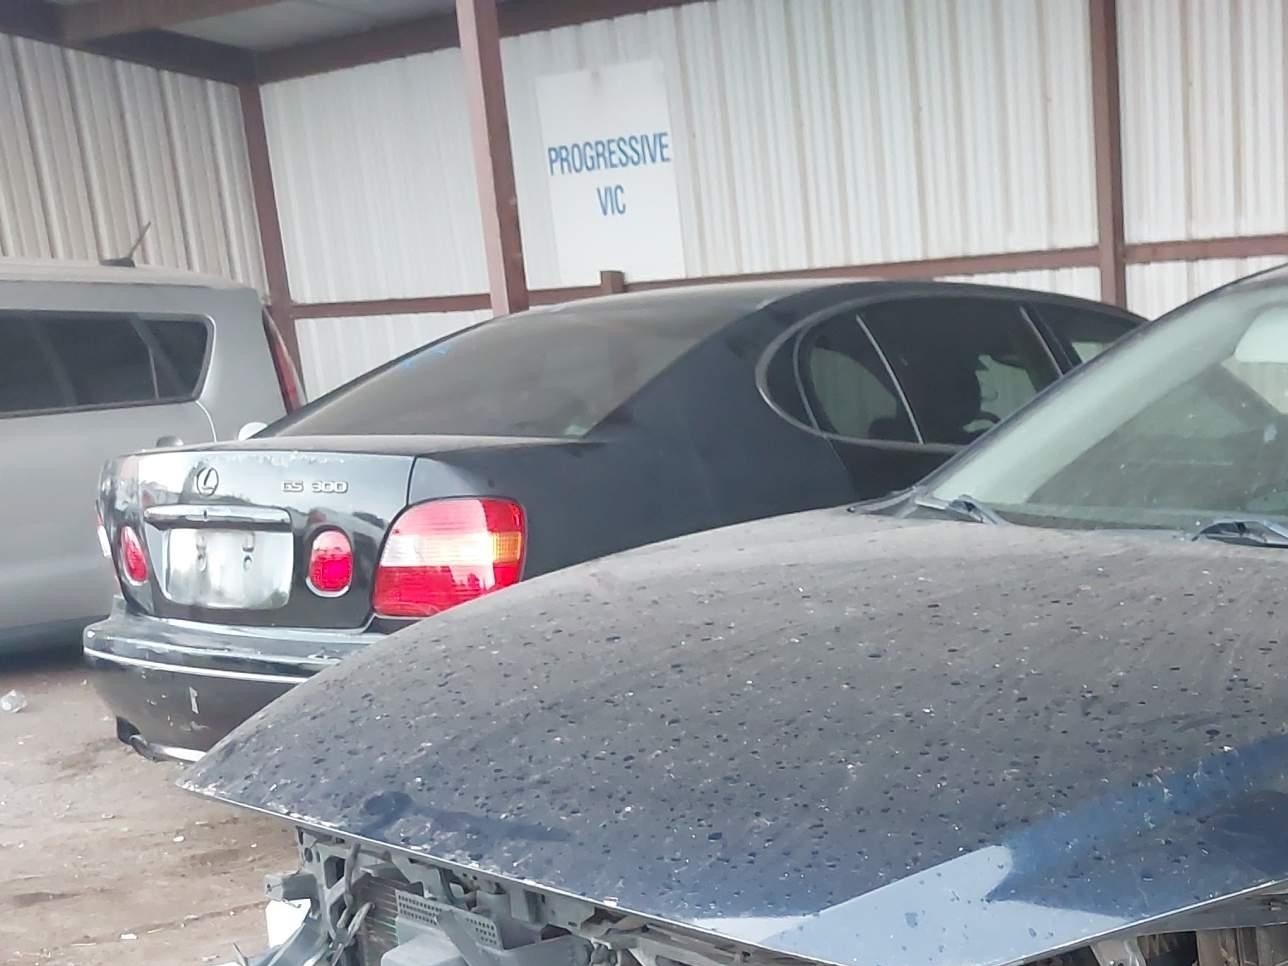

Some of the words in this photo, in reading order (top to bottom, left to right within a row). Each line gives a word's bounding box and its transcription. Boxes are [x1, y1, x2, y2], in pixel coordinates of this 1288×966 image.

[548, 131, 671, 176] PROGRESSIVE
[596, 184, 626, 216] VIC
[281, 479, 305, 493] GS
[311, 480, 349, 494] 300
